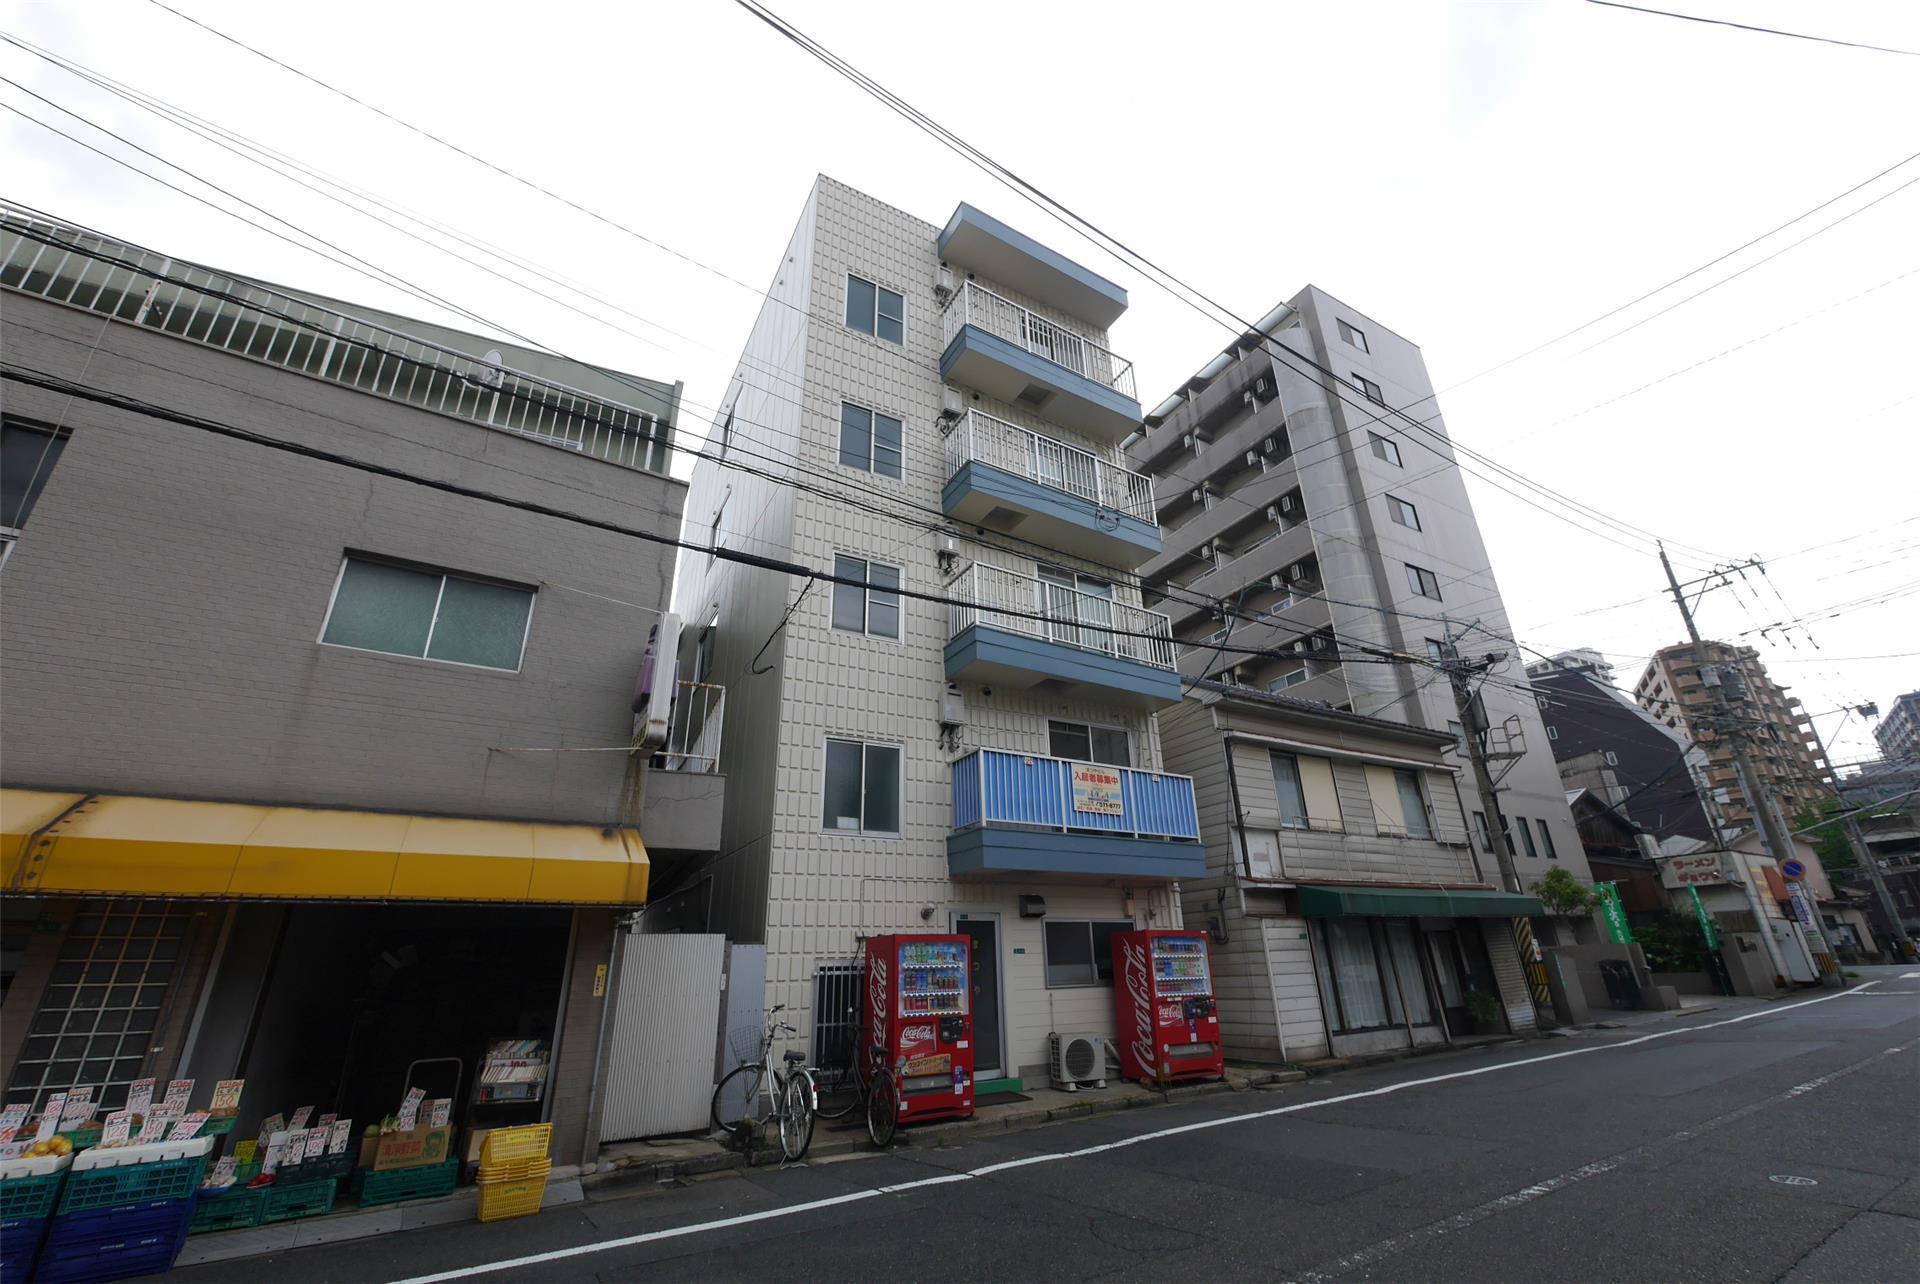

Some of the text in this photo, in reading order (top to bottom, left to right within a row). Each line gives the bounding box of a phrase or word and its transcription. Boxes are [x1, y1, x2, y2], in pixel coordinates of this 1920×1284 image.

[1074, 771, 1119, 785] 入居者募集中
[1672, 856, 1716, 870] ラーメン
[1122, 937, 1157, 1078] Coca-Cola
[1157, 1004, 1183, 1019] Coca-Cola
[902, 1024, 934, 1041] Coca-Cola
